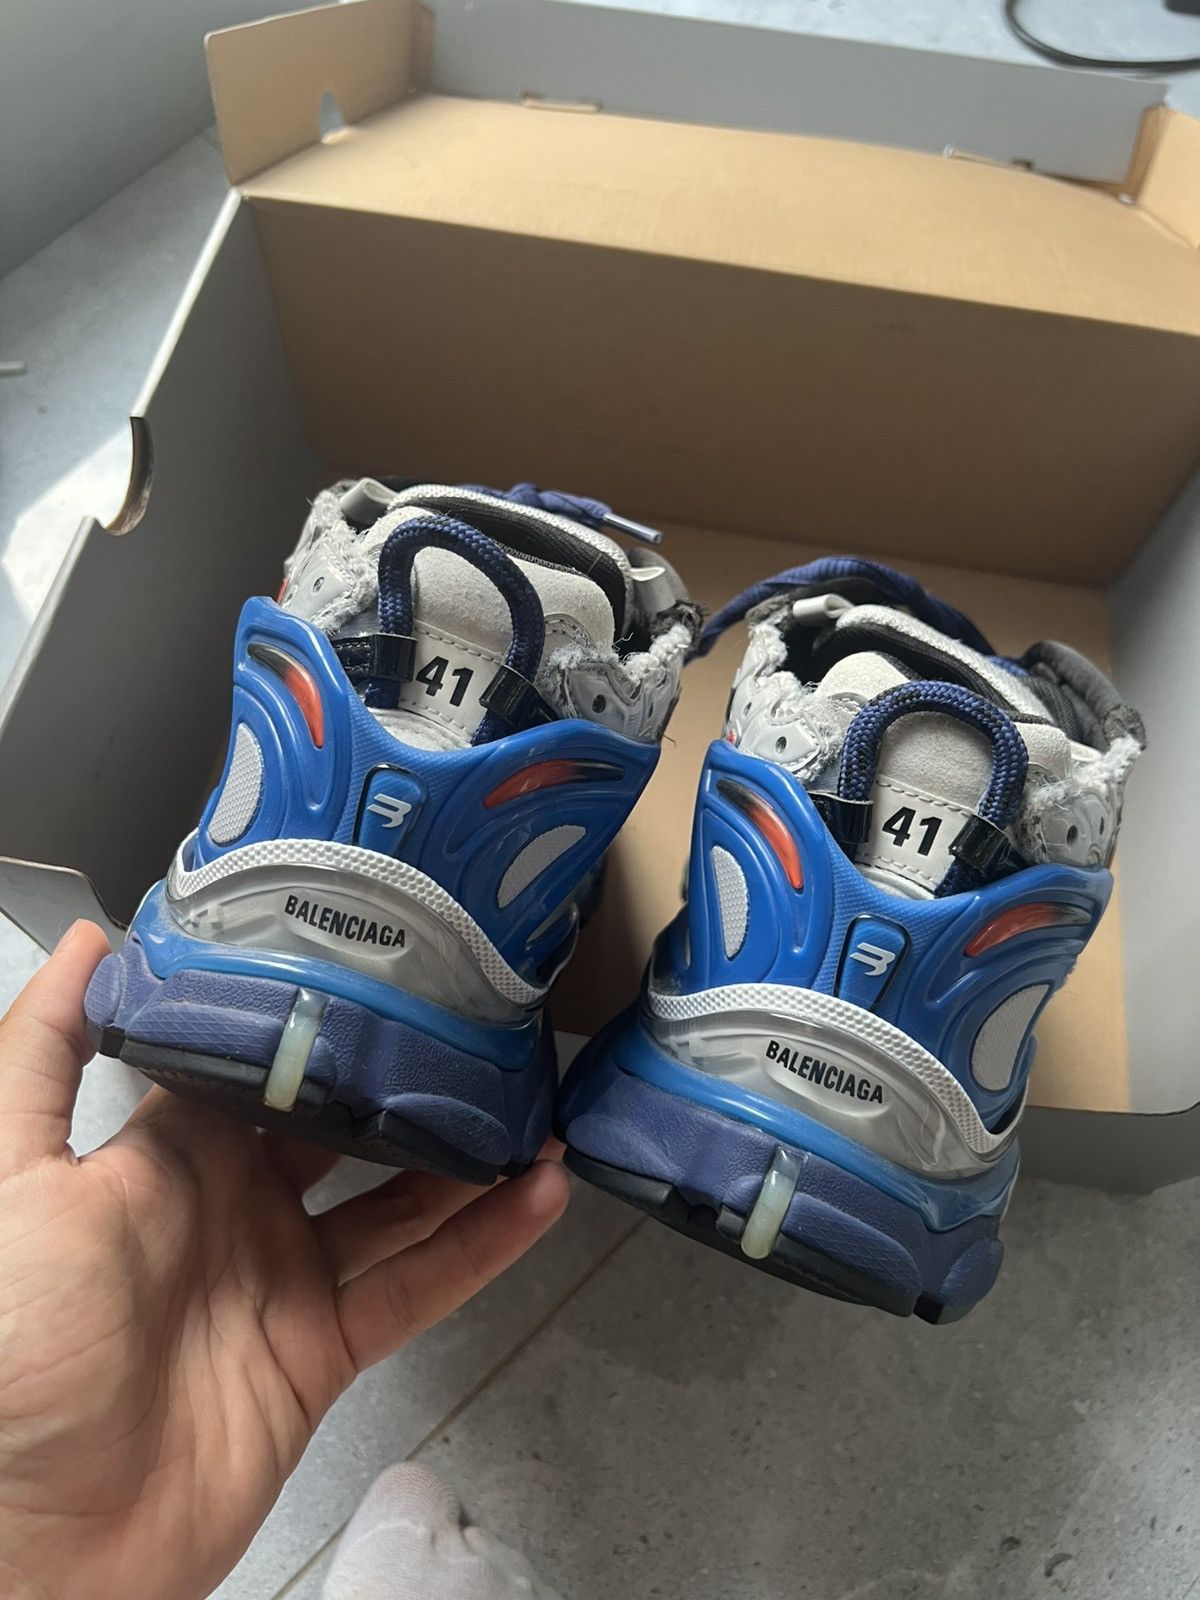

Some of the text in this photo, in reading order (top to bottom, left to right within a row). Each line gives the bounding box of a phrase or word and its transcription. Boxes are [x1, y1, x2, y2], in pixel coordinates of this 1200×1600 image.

[416, 655, 474, 707] 41
[882, 806, 942, 856] 41
[284, 894, 406, 947] BALENCIAGA
[765, 1040, 883, 1103] BALENCIAGA
